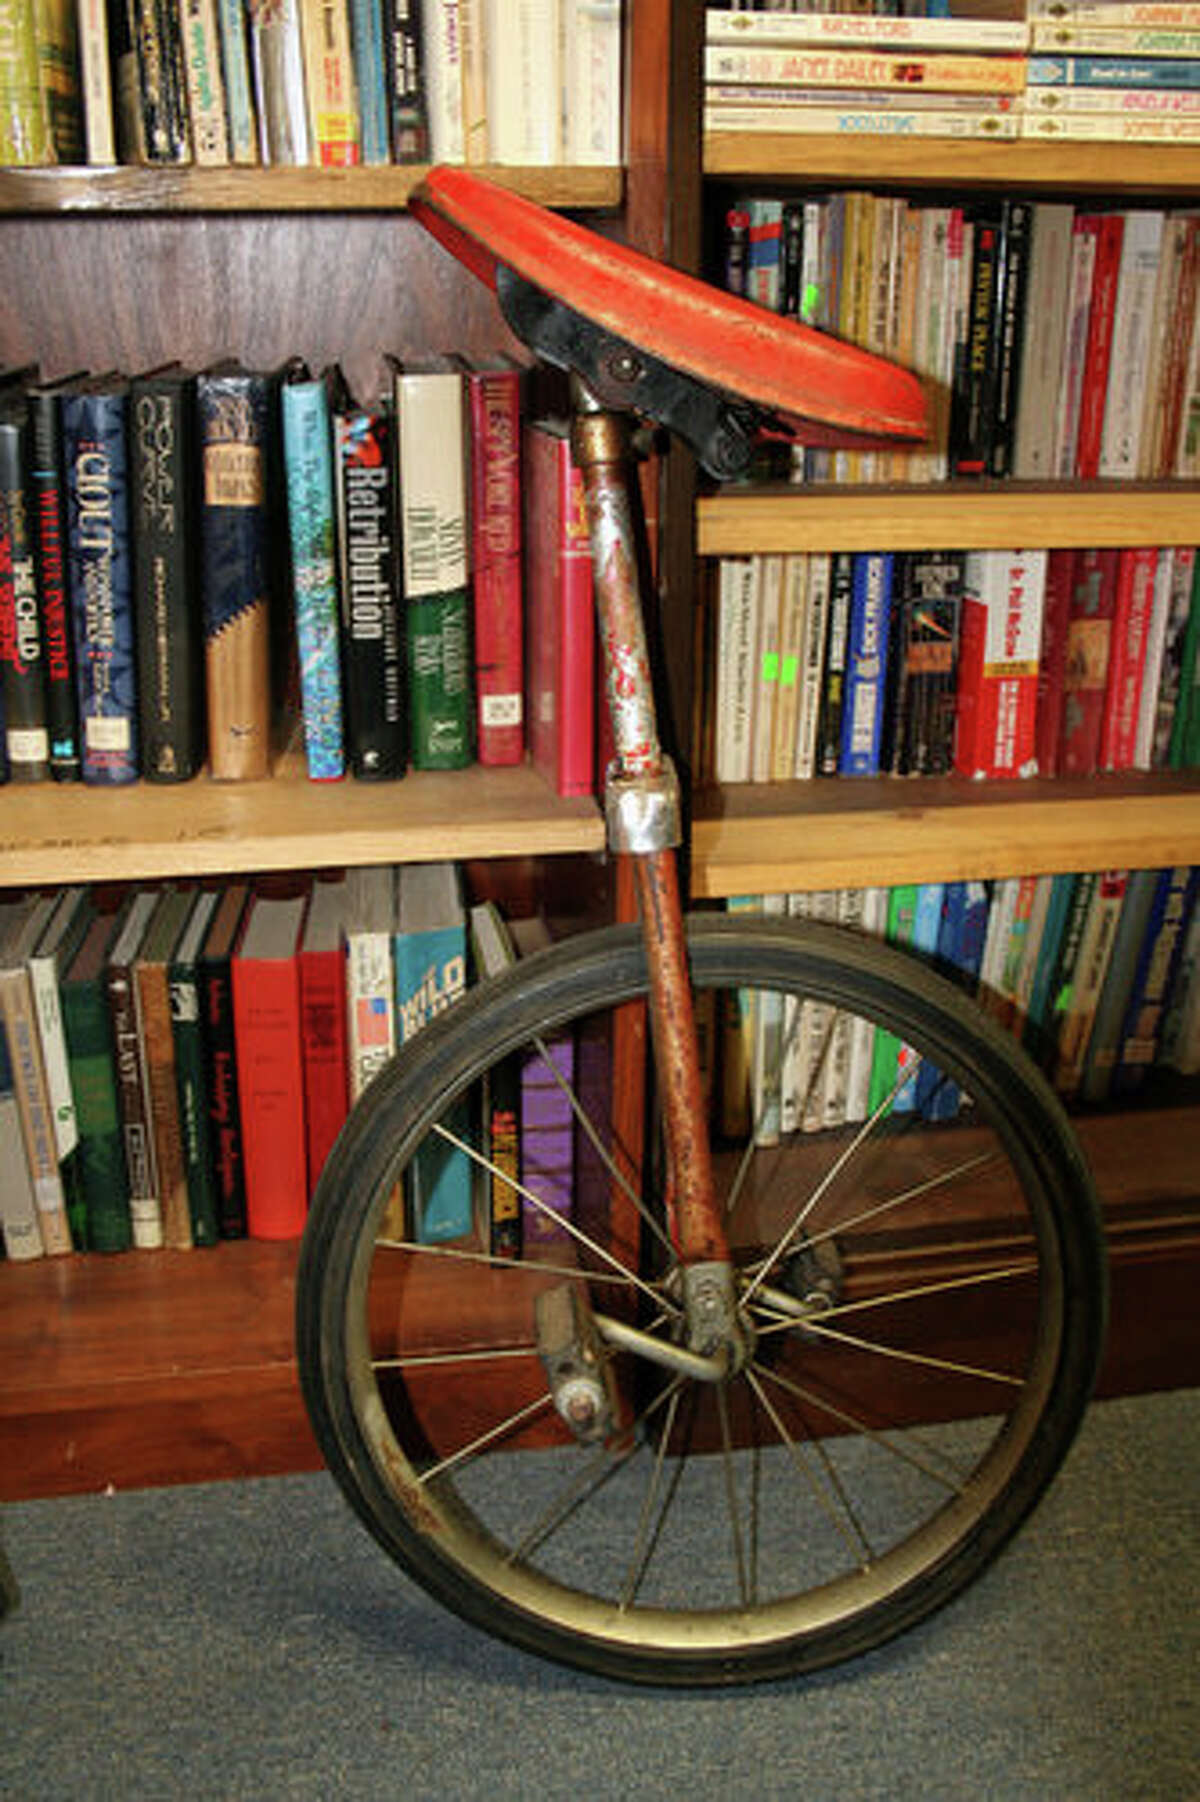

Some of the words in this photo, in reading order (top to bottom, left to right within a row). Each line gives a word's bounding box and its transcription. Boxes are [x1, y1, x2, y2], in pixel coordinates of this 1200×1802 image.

[136, 397, 156, 530] CURVE
[155, 395, 175, 533] POWER
[12, 556, 34, 597] THE
[38, 489, 64, 586] WILLFUL
[346, 466, 390, 641] Retribution
[16, 596, 40, 660] CHILD
[44, 588, 69, 683] INJUSTICE
[117, 1032, 138, 1085] LAST
